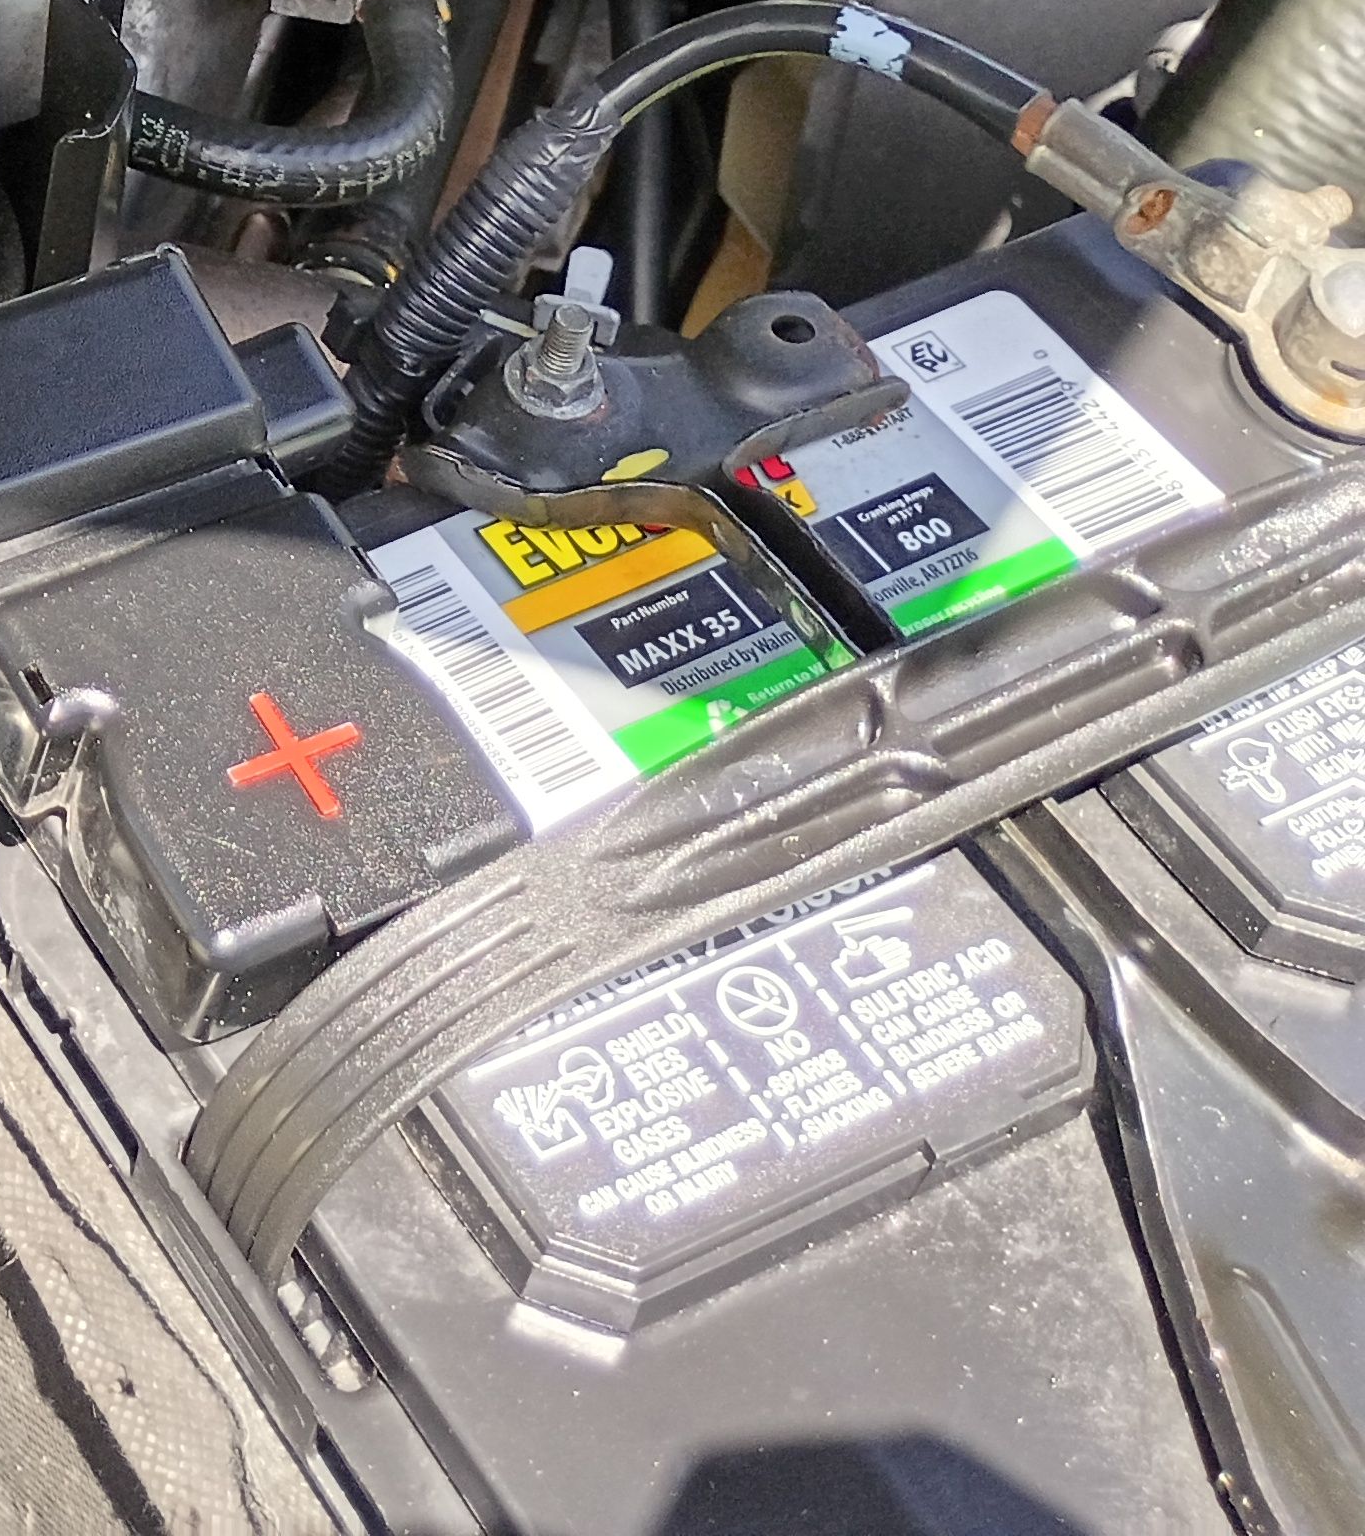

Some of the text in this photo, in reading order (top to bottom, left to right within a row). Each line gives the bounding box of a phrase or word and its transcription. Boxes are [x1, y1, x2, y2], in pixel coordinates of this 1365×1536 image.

[897, 517, 952, 552] 800
[920, 562, 945, 582] AR
[610, 588, 690, 632] Part Number
[616, 608, 742, 676] MAXX 35
[659, 650, 742, 697] Distributed
[739, 641, 760, 664] by
[747, 675, 796, 705] Return
[1265, 704, 1325, 743] FLUSH
[1284, 730, 1336, 764] WITH
[850, 938, 1013, 1025] SULFURIC ACID
[605, 1011, 693, 1065] SHIELD
[870, 984, 981, 1047] CAN CAUSE
[887, 990, 1027, 1069] BLINDNESS OR
[622, 1045, 690, 1092] EYES
[763, 1029, 812, 1067] NO
[906, 1013, 1045, 1092] SEVERE BURNS
[589, 1066, 718, 1141] EXPLOSIVE
[577, 1117, 768, 1215] CAN CAUSE BLINDNESS
[612, 1115, 693, 1166] GASES
[644, 1159, 739, 1216] OR INJURY
